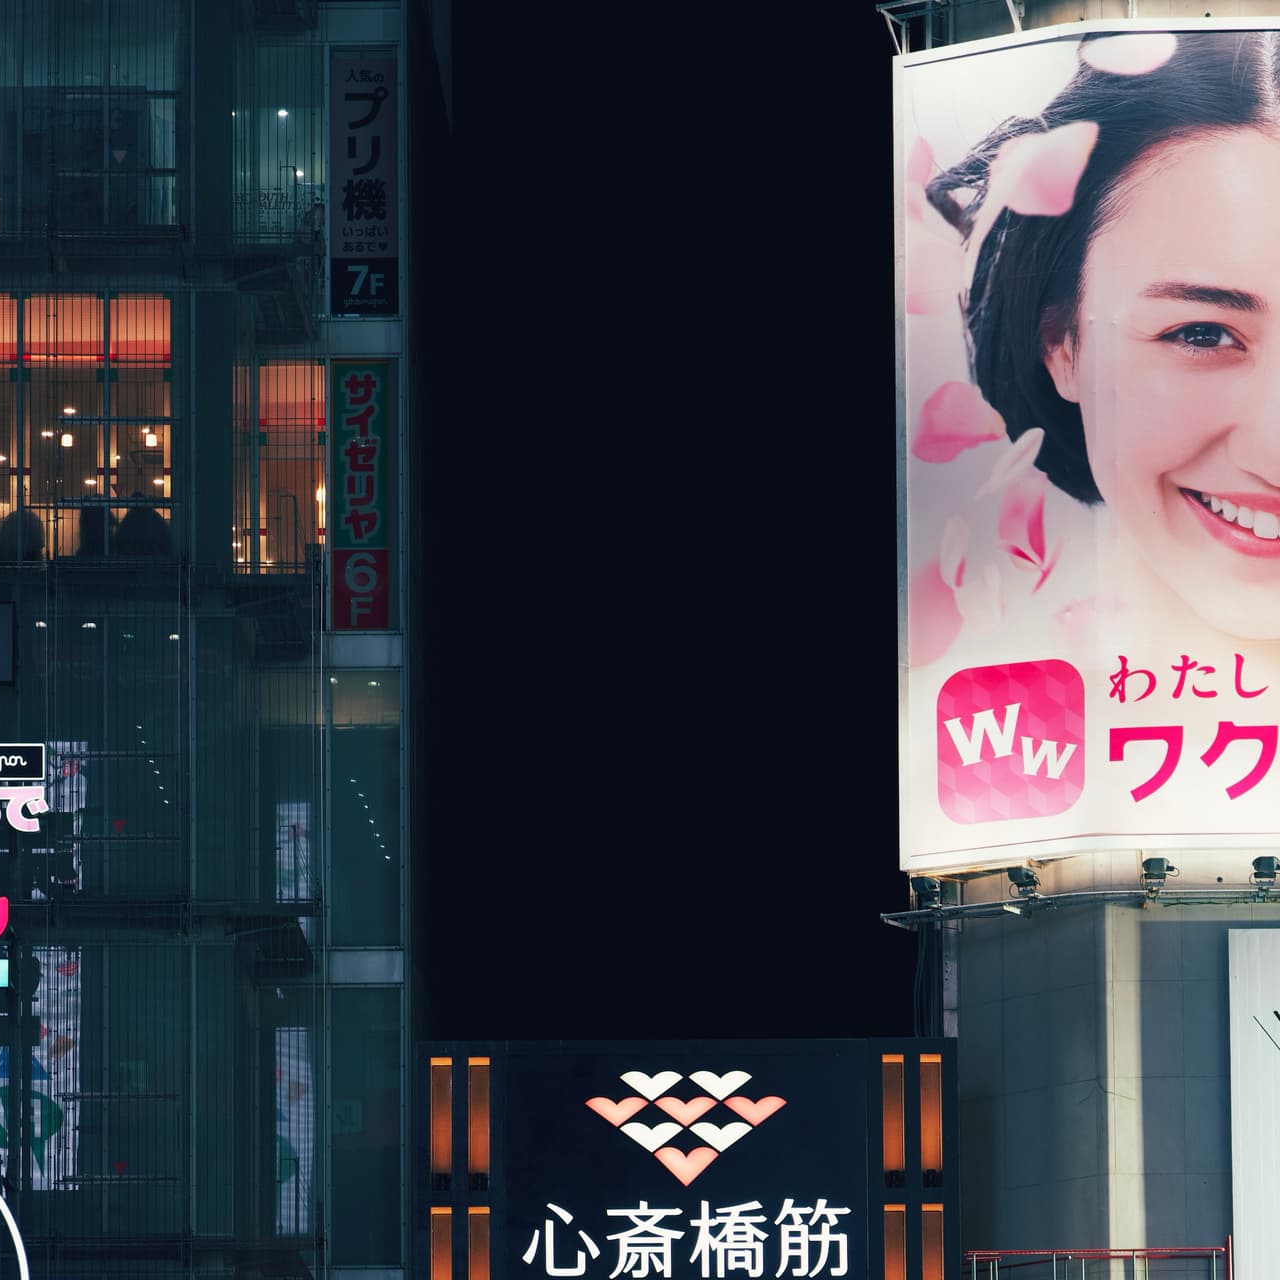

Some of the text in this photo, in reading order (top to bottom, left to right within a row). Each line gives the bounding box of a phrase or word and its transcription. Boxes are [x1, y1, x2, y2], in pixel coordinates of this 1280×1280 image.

[341, 86, 389, 221] プリ機
[347, 264, 385, 296] 7F
[340, 372, 381, 546] サイゼリヤ
[340, 551, 378, 628] 6F
[522, 1198, 852, 1280] 心斎橋筋
